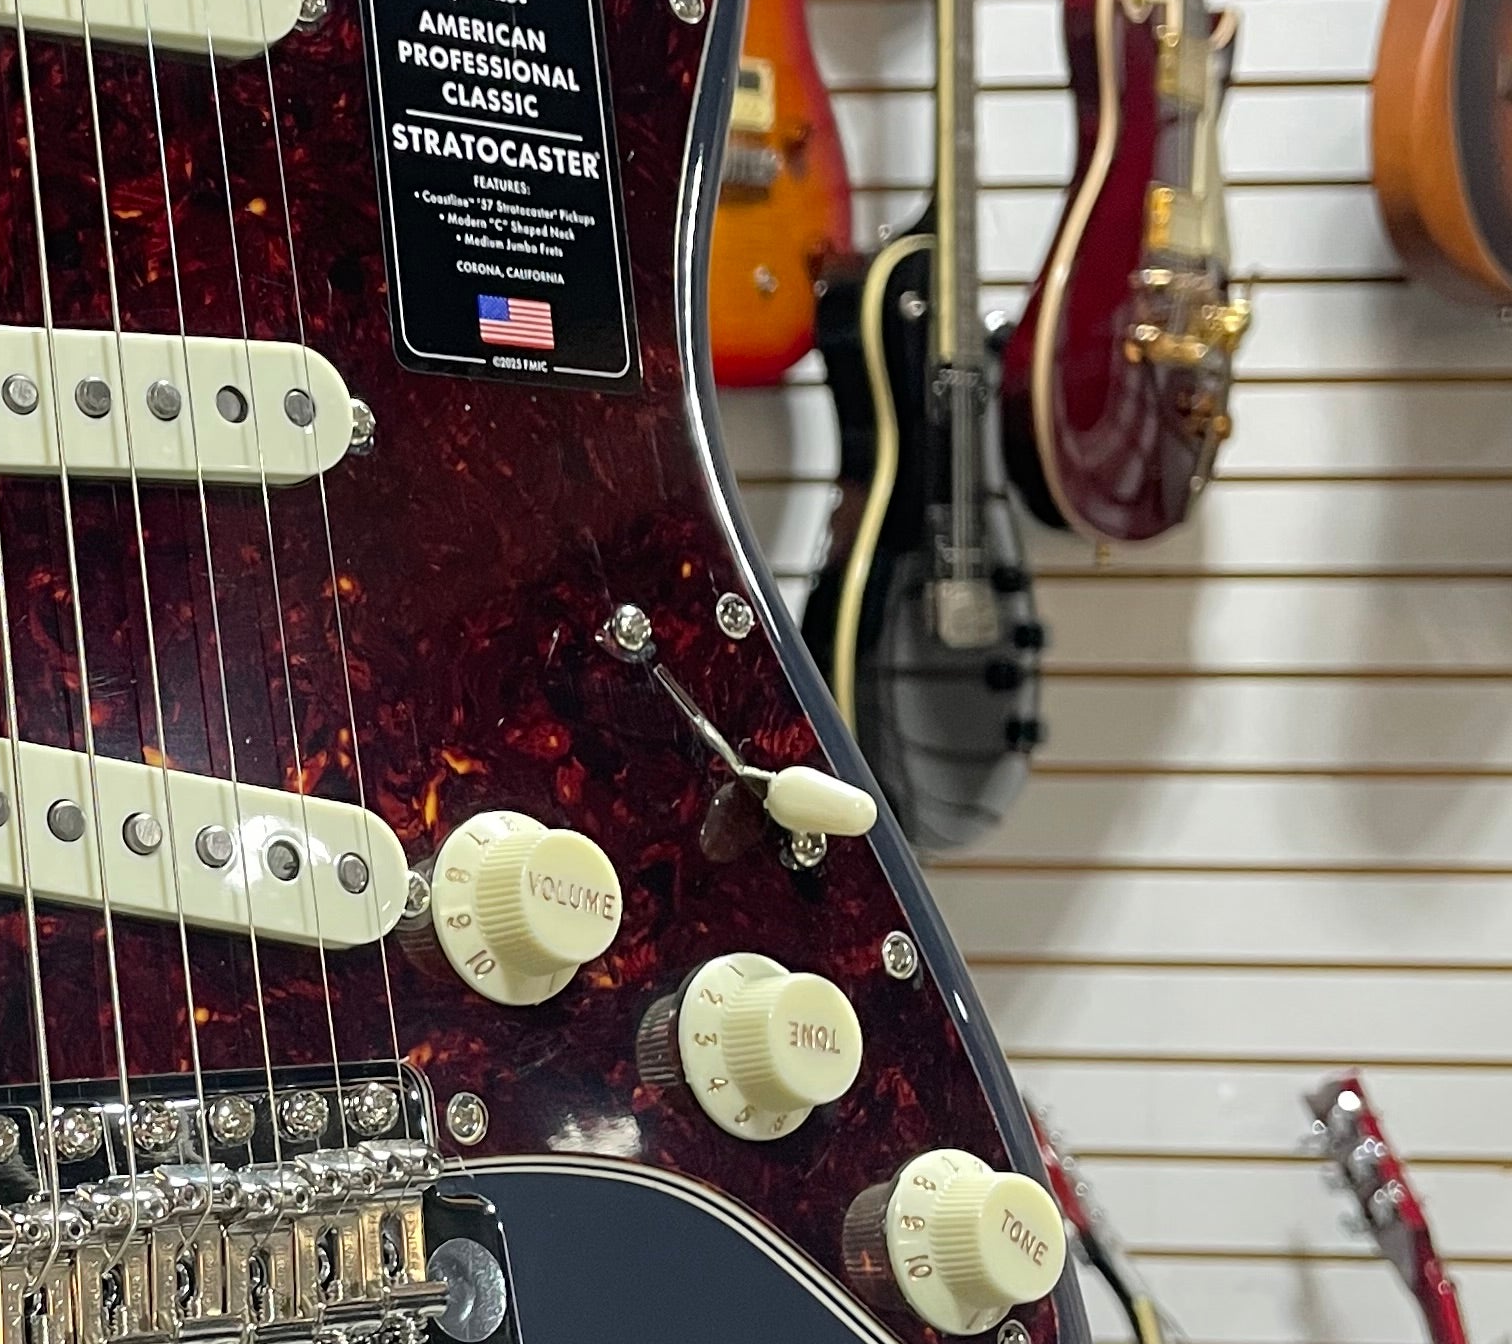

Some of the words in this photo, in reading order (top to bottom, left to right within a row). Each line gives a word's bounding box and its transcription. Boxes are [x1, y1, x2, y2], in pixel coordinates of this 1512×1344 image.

[418, 9, 547, 54] AMERICAN
[397, 38, 580, 93] PROFESSIONAL
[441, 80, 539, 119] CLASSIC
[472, 174, 532, 196] FEATURES:
[446, 212, 487, 230] Modern
[510, 220, 548, 238] Shaped
[549, 225, 576, 242] Neck
[559, 208, 596, 228] Pickups
[463, 233, 505, 250] Medium
[506, 237, 538, 255] Jumbo
[539, 242, 564, 258] Frets
[456, 259, 505, 278] CORONA,
[506, 266, 565, 285] CALIFORNIA
[523, 358, 548, 374] FMIC
[528, 871, 616, 921] VOLUME
[464, 949, 496, 981] 10
[788, 1020, 841, 1055] TONE
[1000, 1208, 1049, 1267] TONE
[903, 1254, 933, 1281] 10
